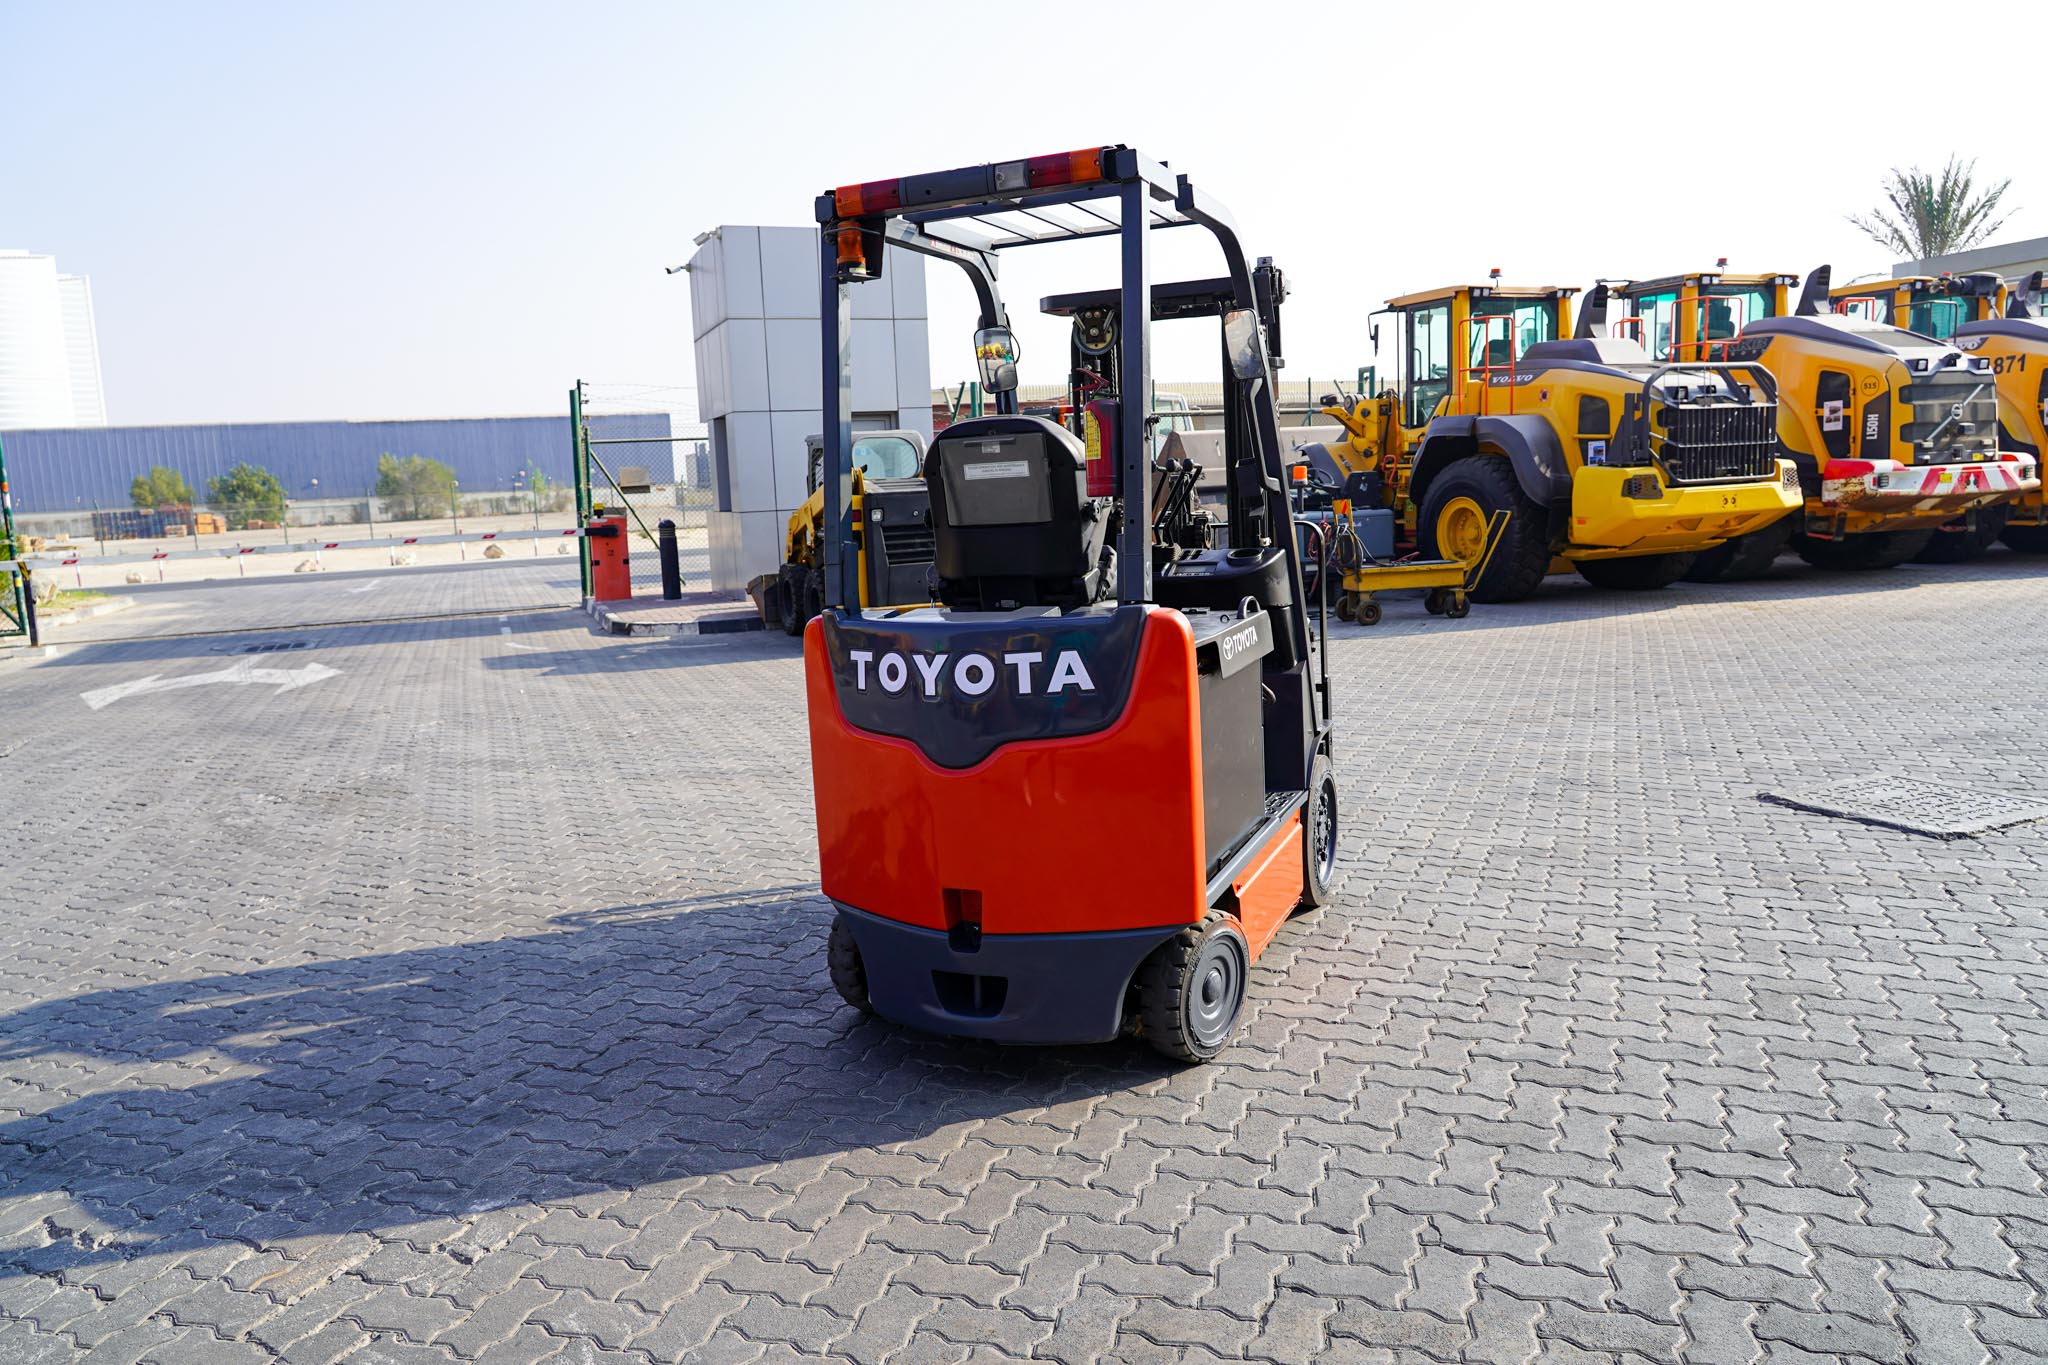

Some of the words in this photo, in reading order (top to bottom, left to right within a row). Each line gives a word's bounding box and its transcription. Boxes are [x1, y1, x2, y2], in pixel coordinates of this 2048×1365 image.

[1993, 353, 2026, 375] 871
[1863, 382, 1877, 390] 515
[1866, 413, 1879, 440] L150H
[1232, 625, 1258, 654] TOYOTA
[850, 650, 1096, 696] TOYOTA
